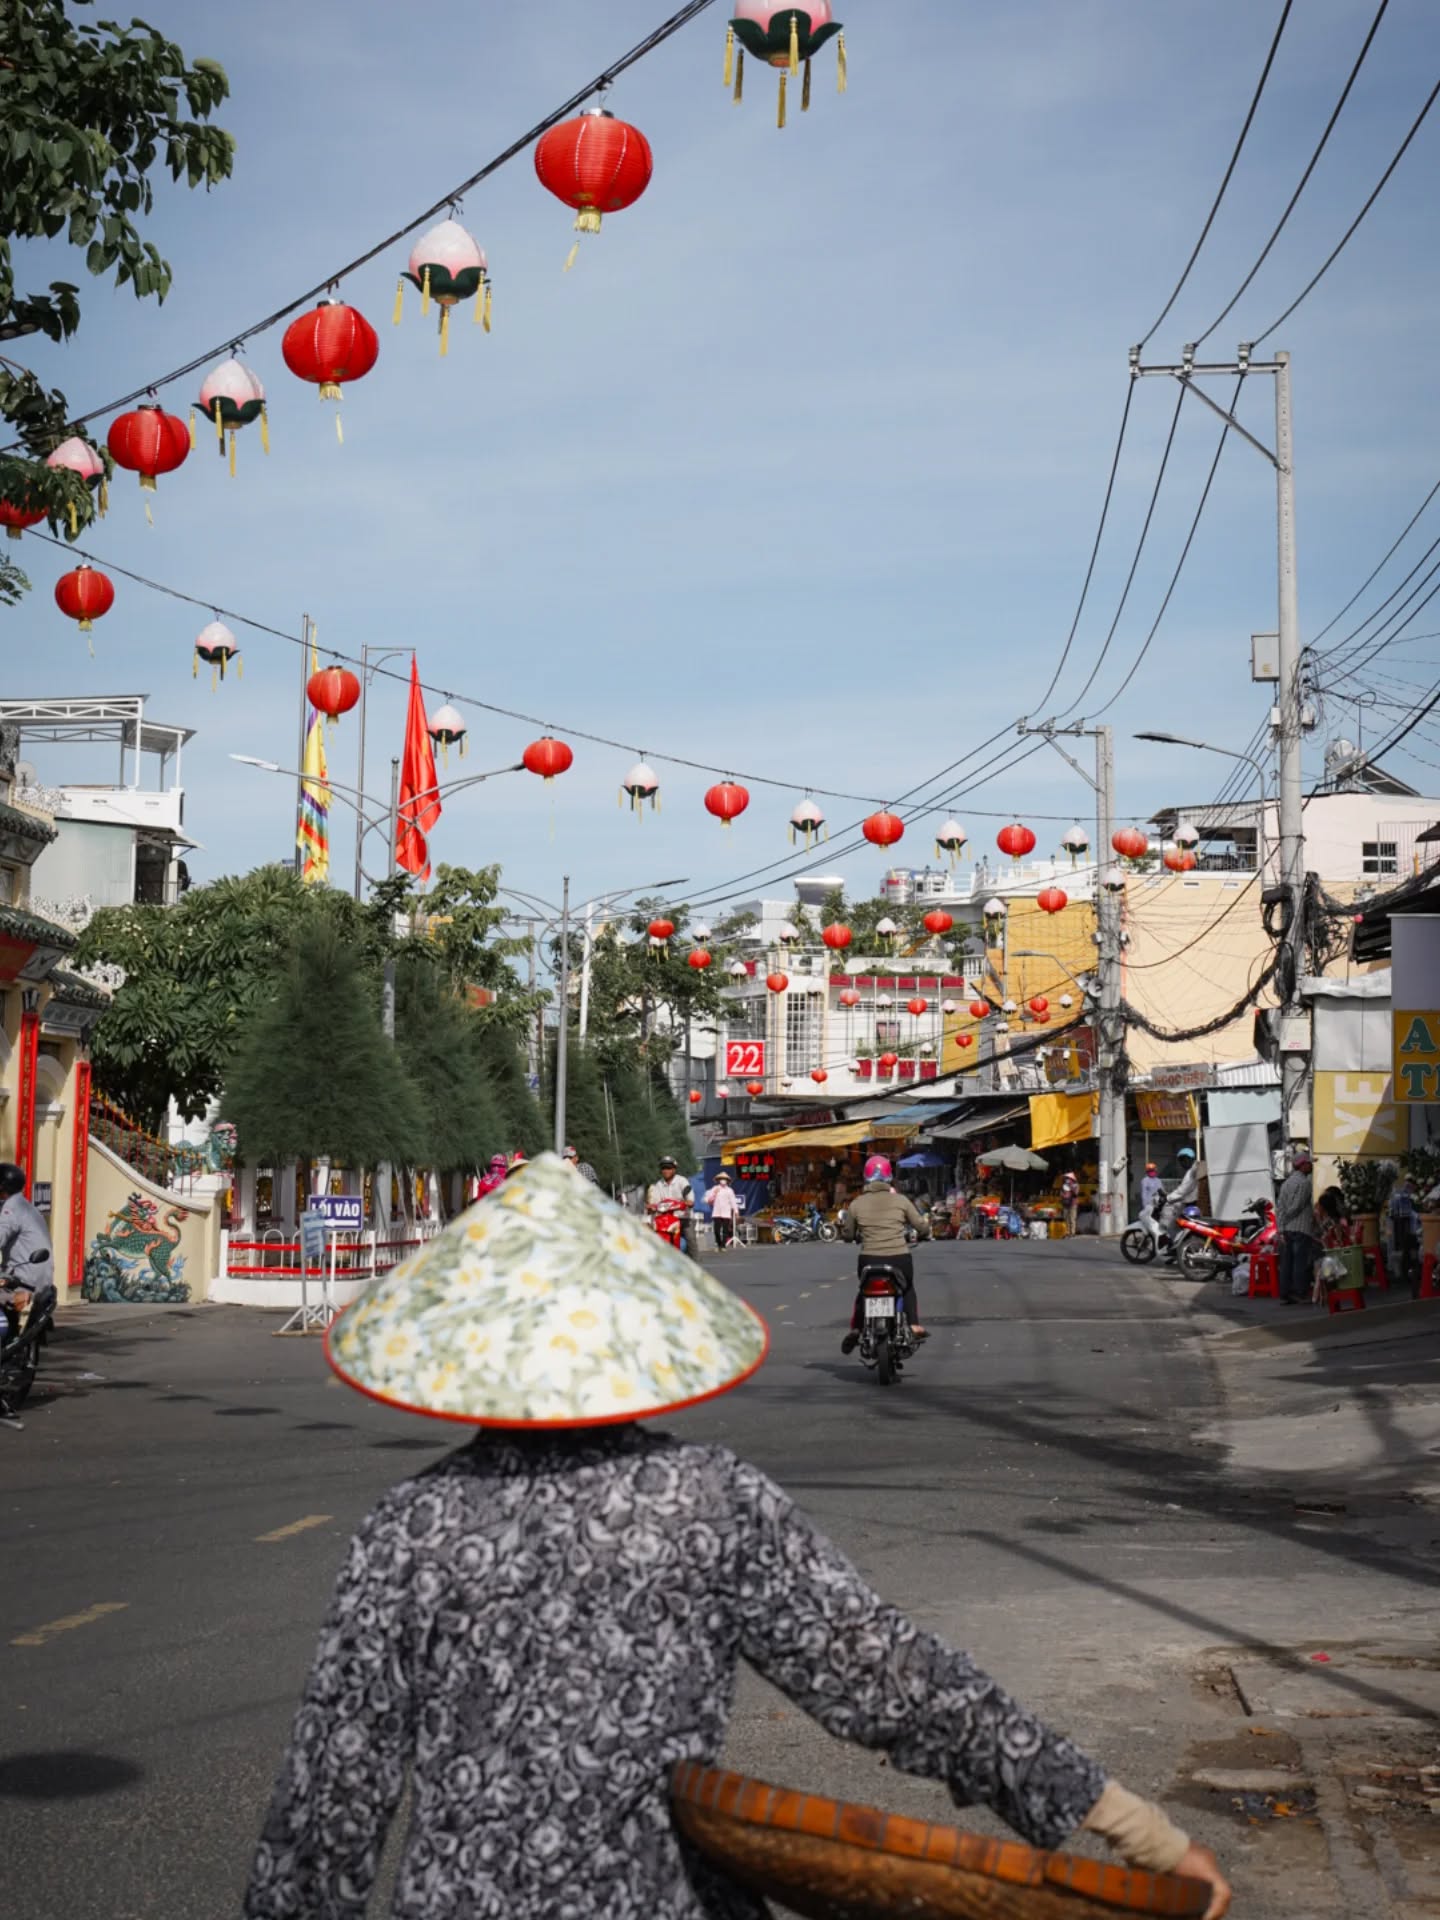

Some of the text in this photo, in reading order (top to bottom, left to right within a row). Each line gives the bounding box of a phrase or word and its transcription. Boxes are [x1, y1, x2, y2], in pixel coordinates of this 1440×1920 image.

[1400, 1016, 1440, 1053] A
[730, 1044, 761, 1073] 22
[1401, 1062, 1440, 1098] T
[334, 1200, 360, 1217] VÀO
